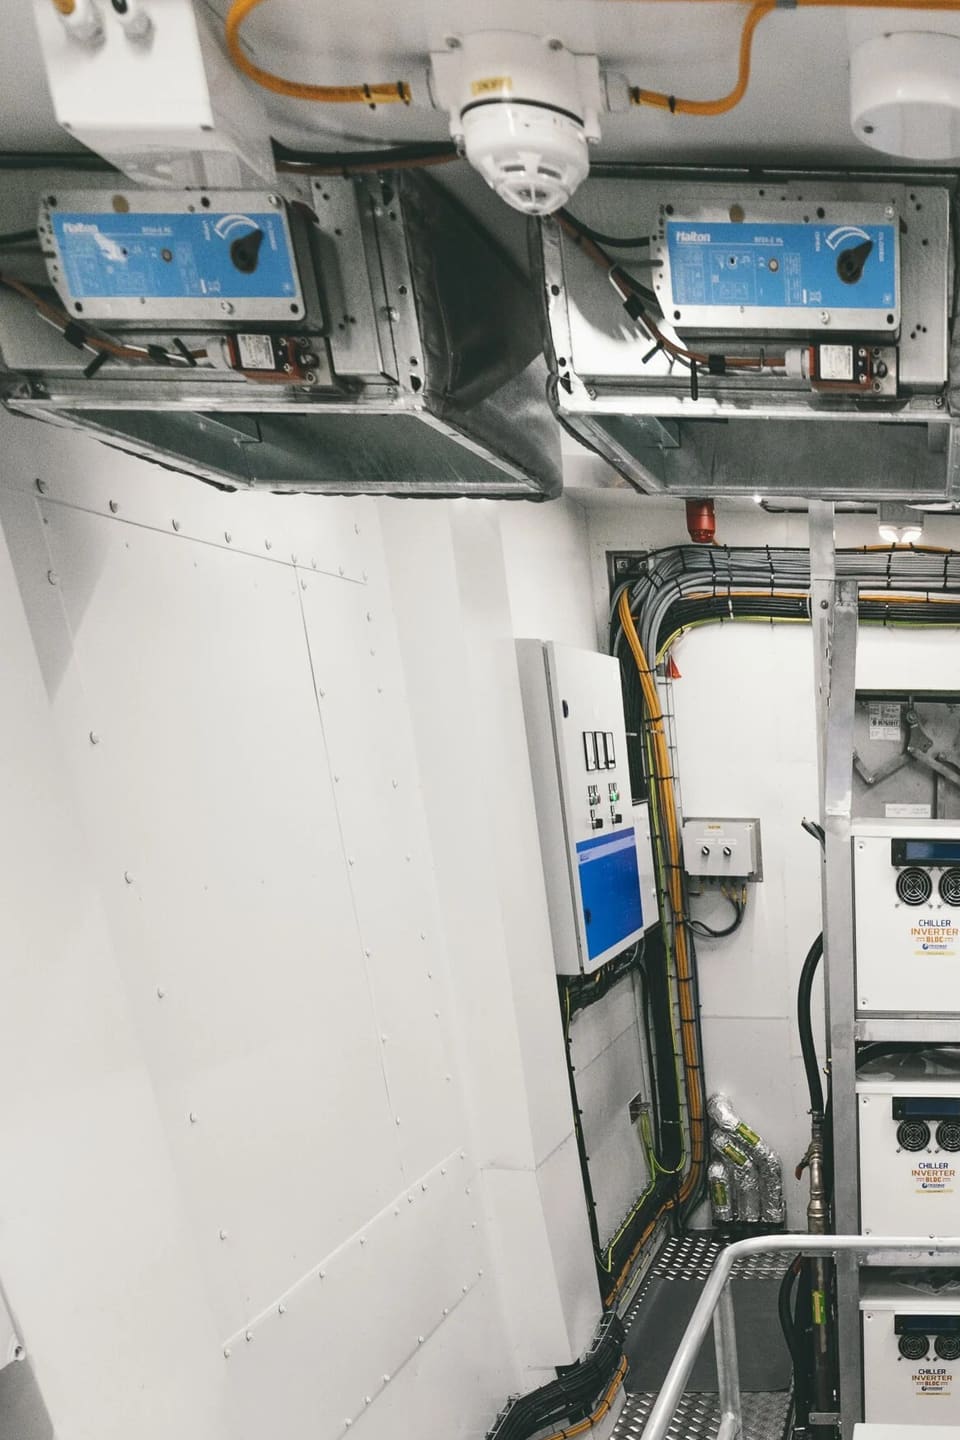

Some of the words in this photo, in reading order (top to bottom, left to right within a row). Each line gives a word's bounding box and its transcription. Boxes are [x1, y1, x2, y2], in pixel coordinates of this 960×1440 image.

[676, 231, 711, 242] Halton
[918, 919, 951, 927] CHILLER
[911, 928, 959, 936] INVERTER
